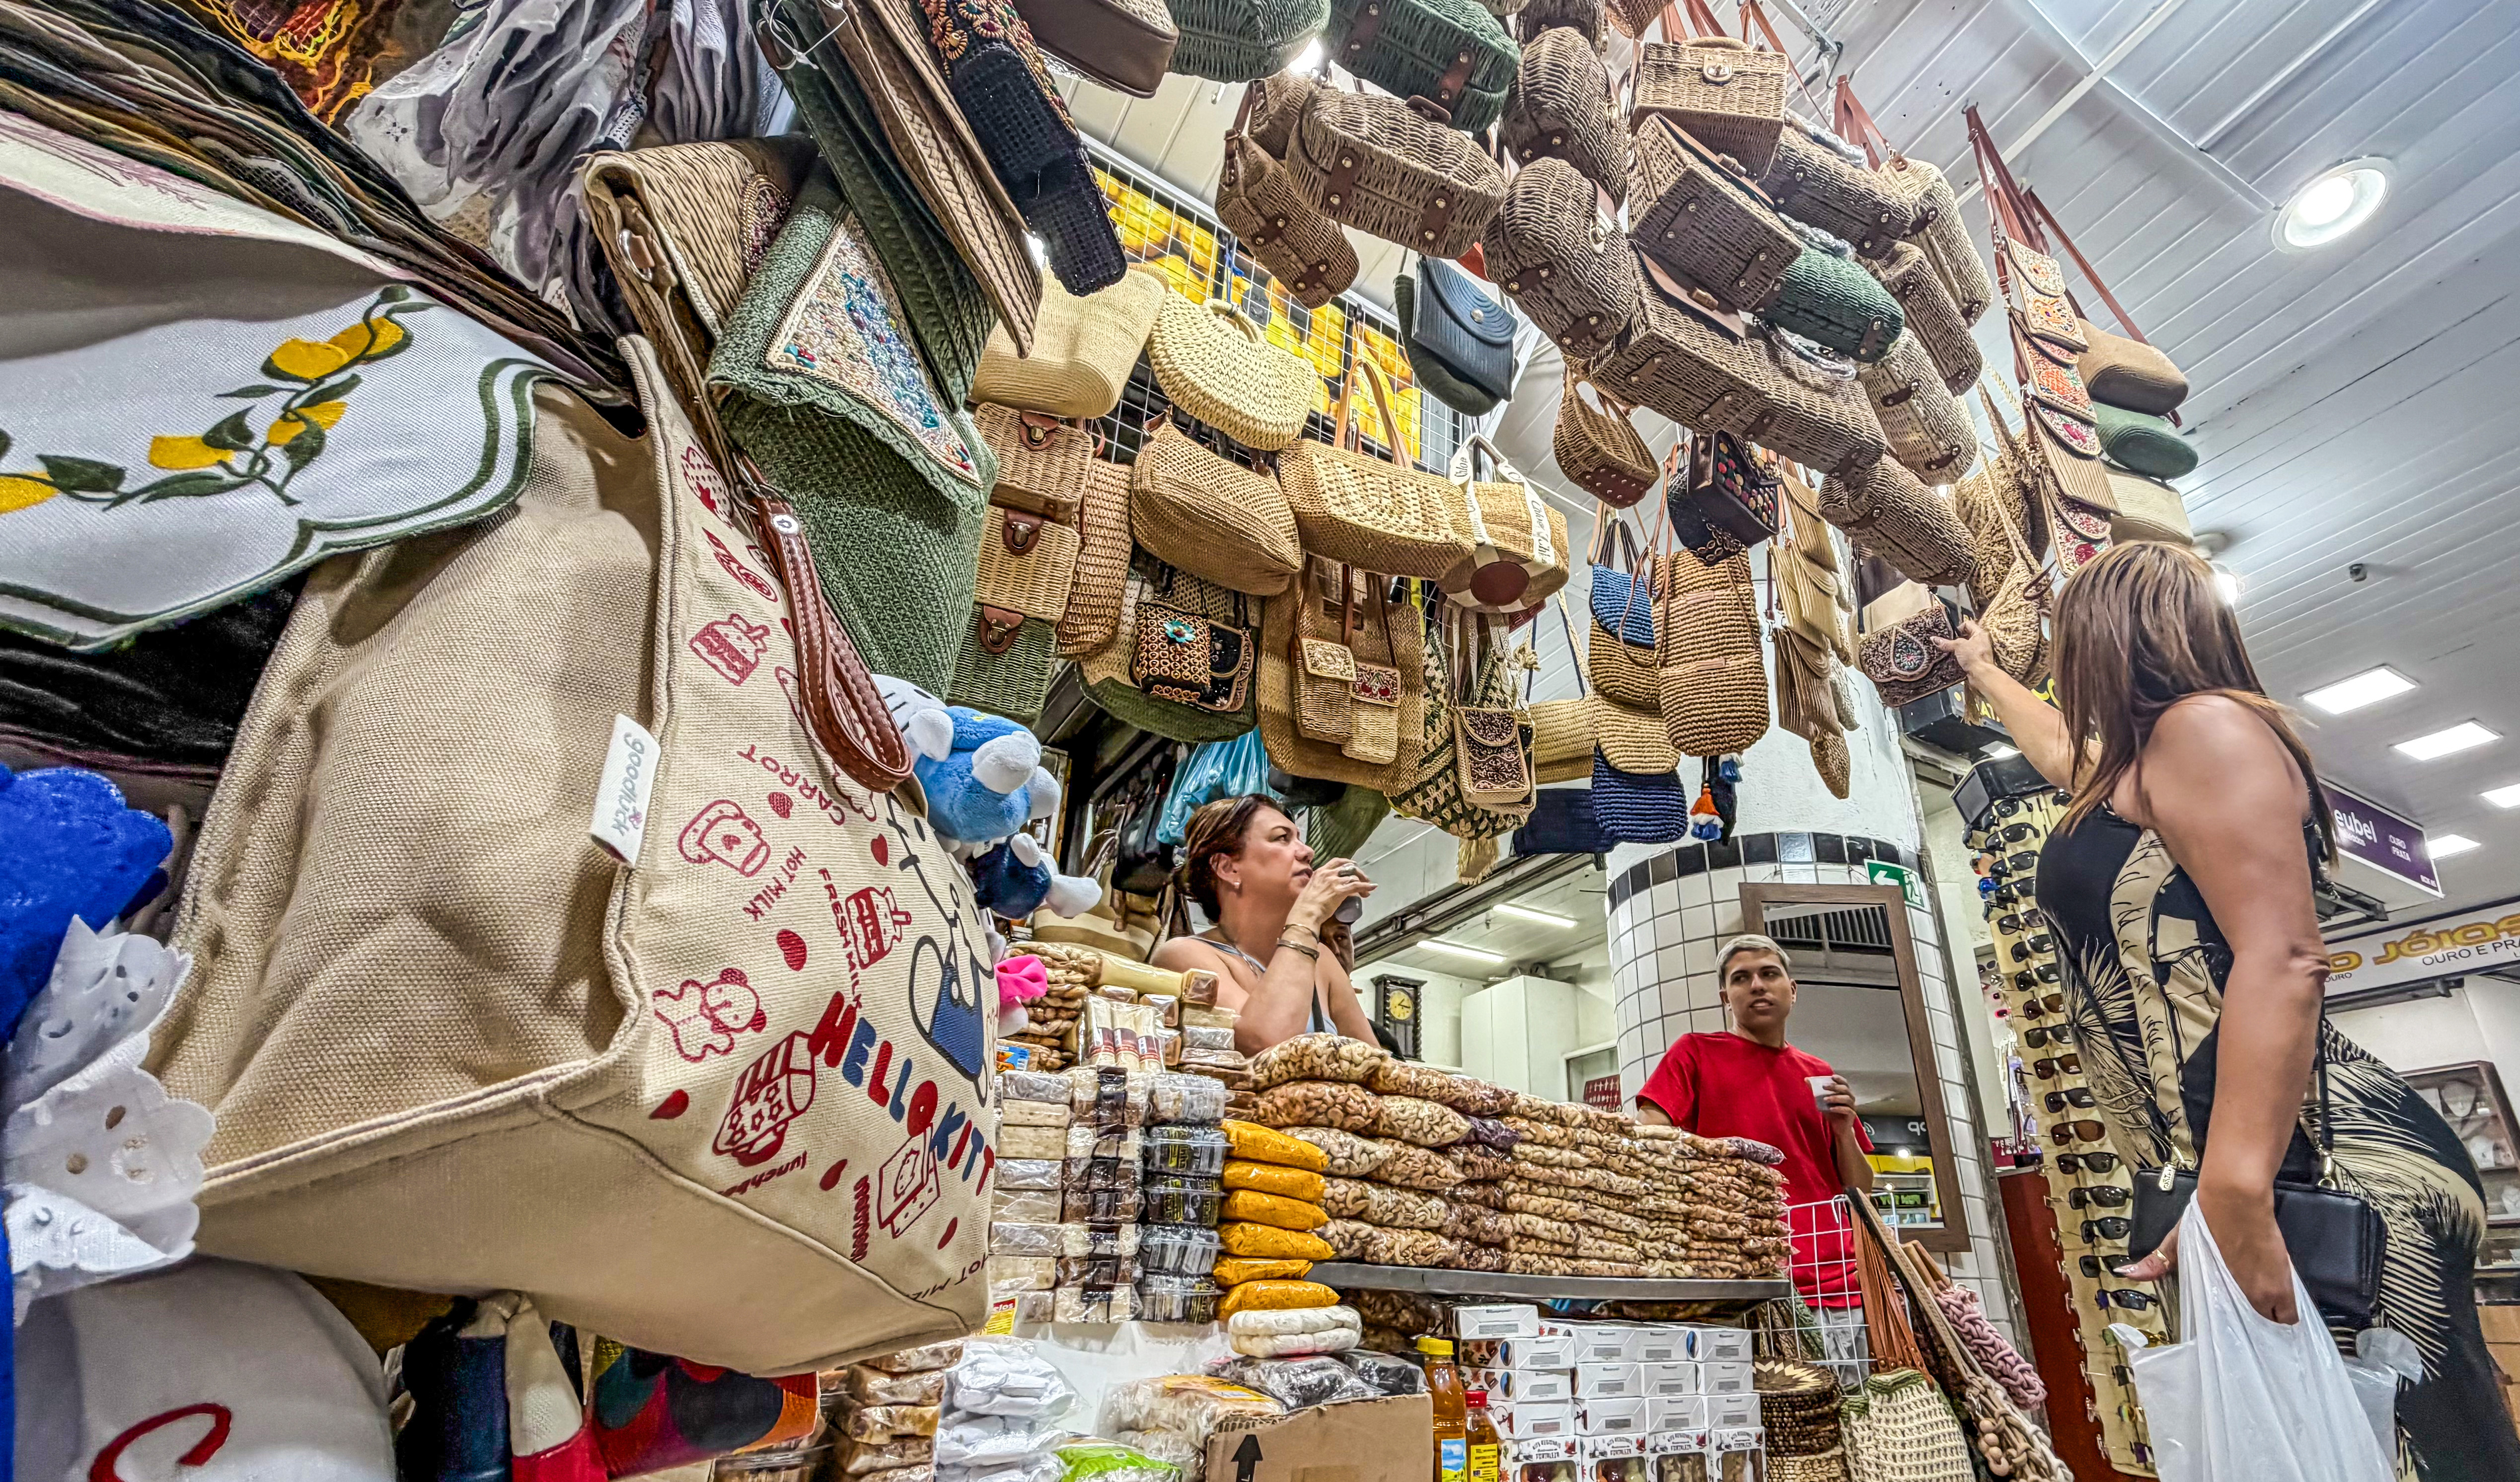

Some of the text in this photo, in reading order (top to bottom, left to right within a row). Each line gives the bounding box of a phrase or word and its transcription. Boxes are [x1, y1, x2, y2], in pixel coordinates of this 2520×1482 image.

[611, 732, 645, 837] goodluck
[737, 744, 845, 826] CARROT
[742, 845, 807, 922] HOT MILK
[818, 867, 852, 949] FRESH
[2422, 948, 2471, 966] OURO
[2476, 945, 2488, 955] E
[808, 991, 938, 1137] HELLO
[912, 1277, 951, 1301] MIL
